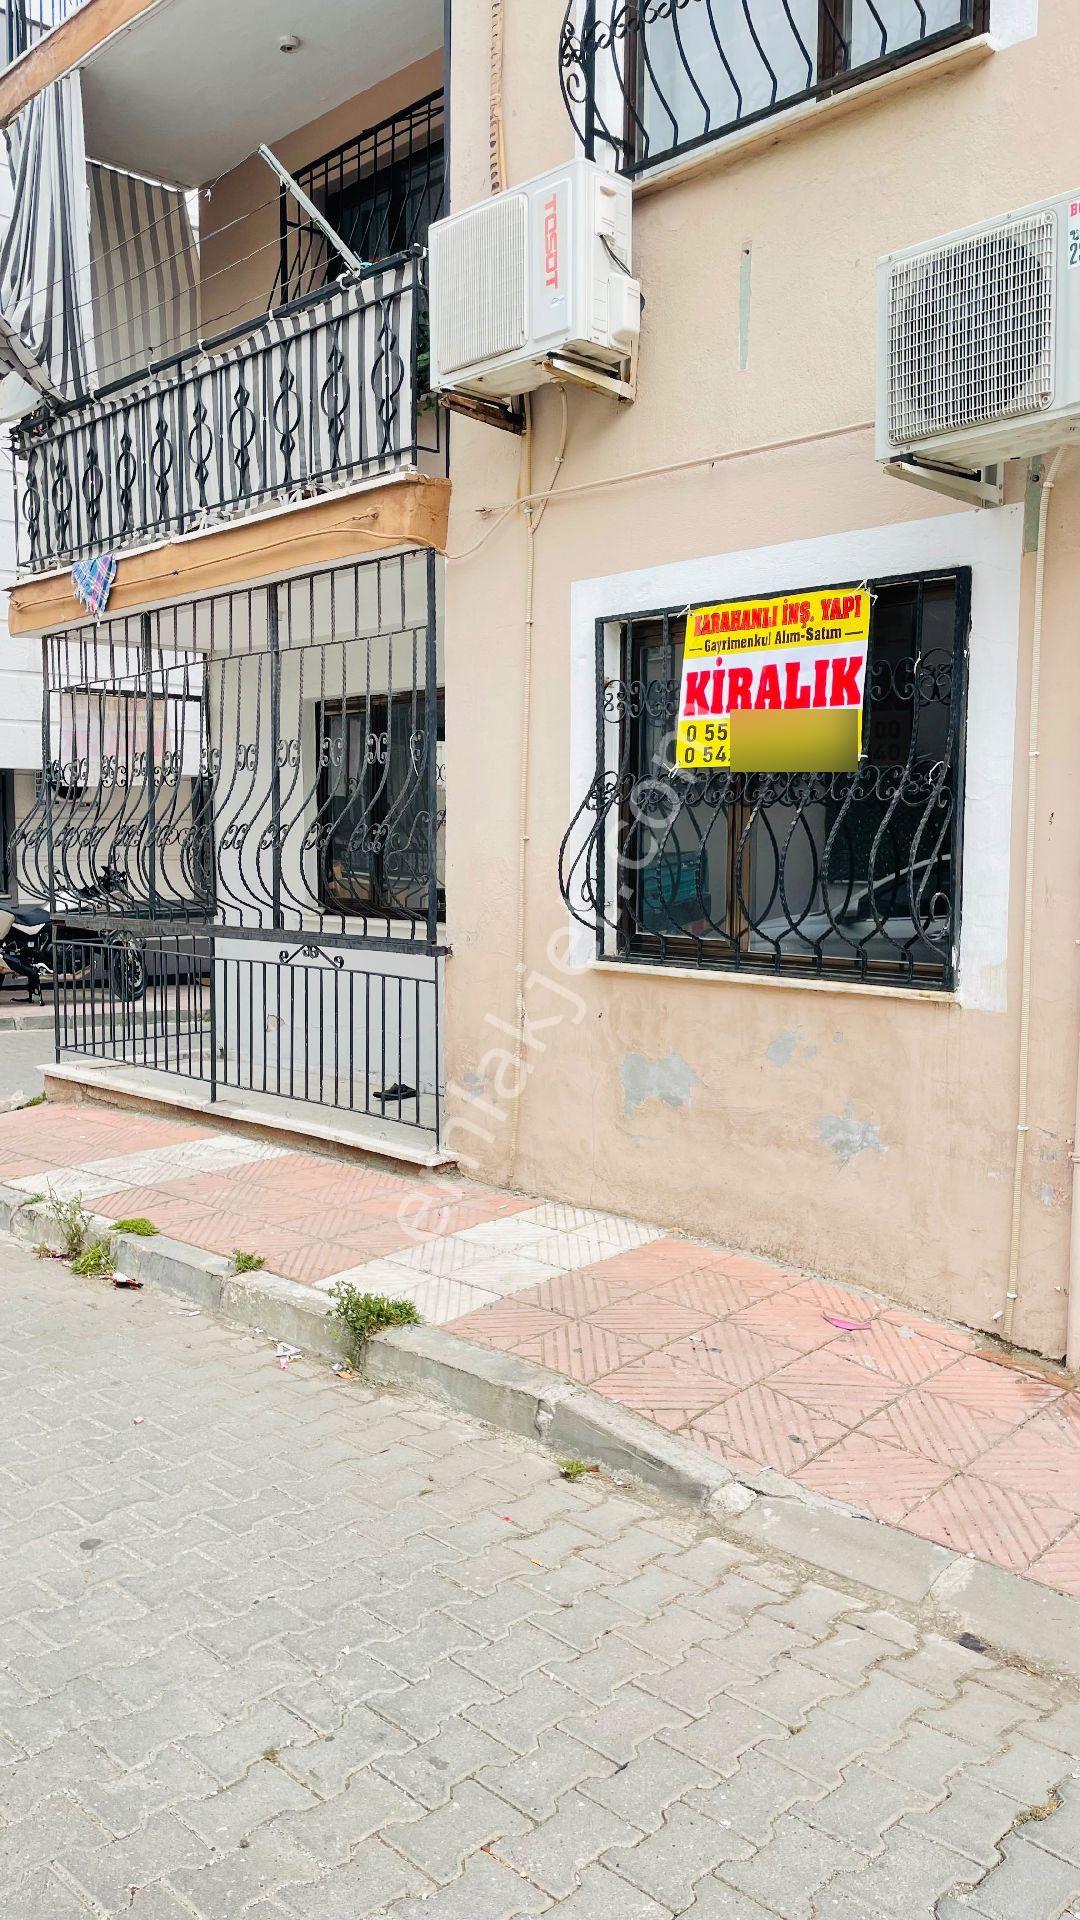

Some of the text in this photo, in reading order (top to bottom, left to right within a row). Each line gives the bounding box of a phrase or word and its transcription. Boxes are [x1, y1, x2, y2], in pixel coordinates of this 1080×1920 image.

[544, 193, 559, 289] TOSOT
[782, 599, 815, 628] İNŞ.
[820, 595, 862, 621] YAPI
[704, 627, 842, 654] Gayrimenkul Alım-Satım
[683, 657, 863, 717] KİRALIK
[704, 723, 729, 742] 55
[703, 746, 730, 763] 54
